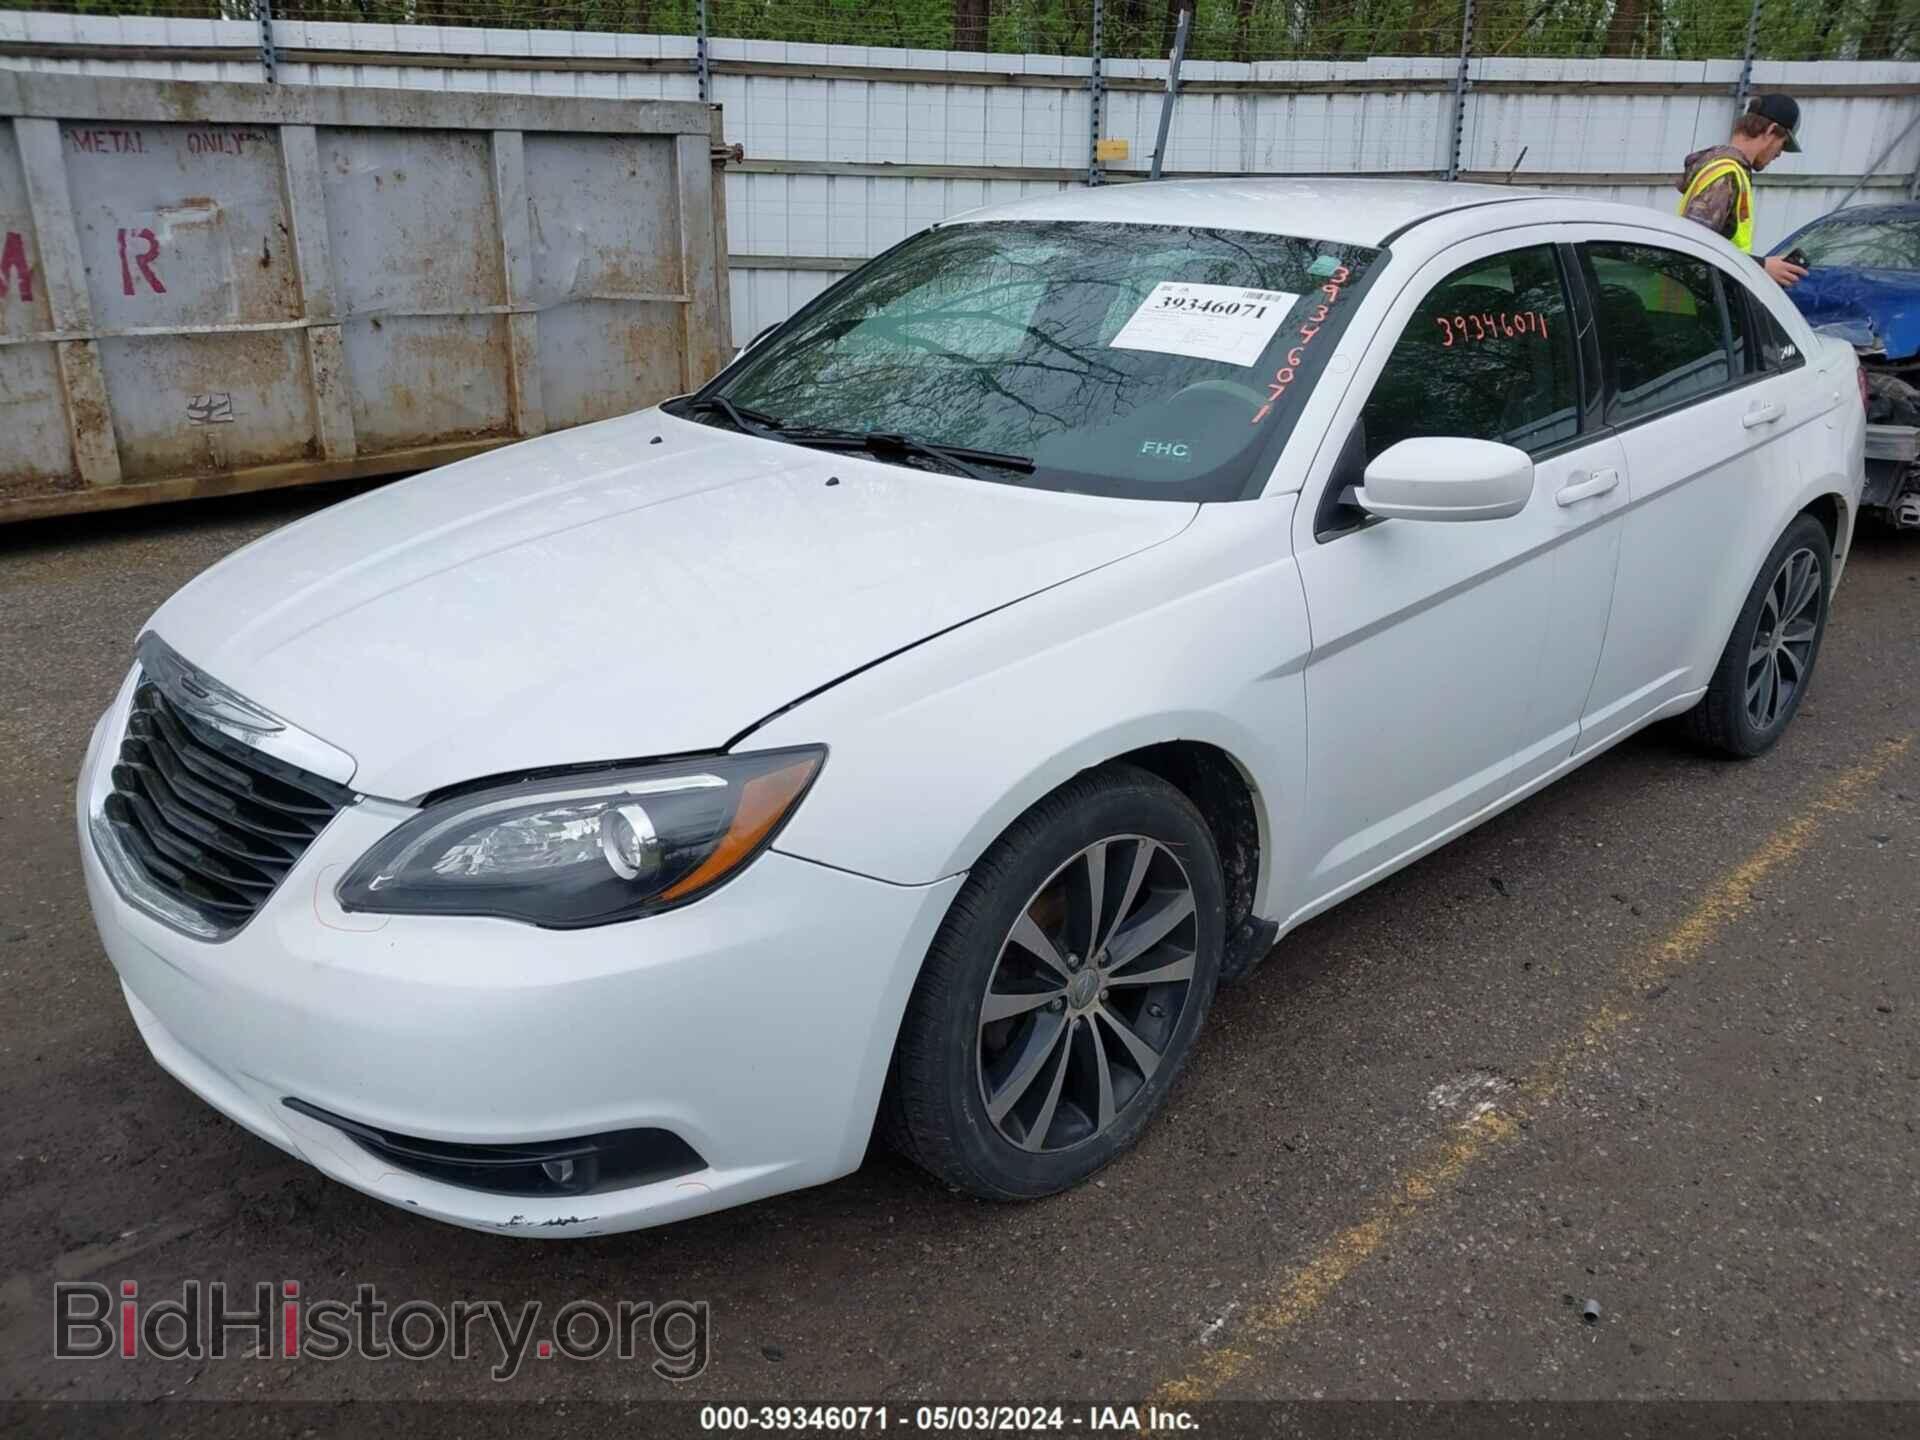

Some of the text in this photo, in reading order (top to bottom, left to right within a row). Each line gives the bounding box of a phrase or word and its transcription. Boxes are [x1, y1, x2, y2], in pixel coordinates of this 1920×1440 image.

[70, 128, 148, 154] METAL
[186, 130, 244, 154] ONLY
[117, 227, 166, 296] R
[1155, 296, 1268, 319] 39346071
[1437, 311, 1548, 346] 39346071
[1251, 266, 1350, 424] 39346071
[1142, 440, 1188, 456] FHC
